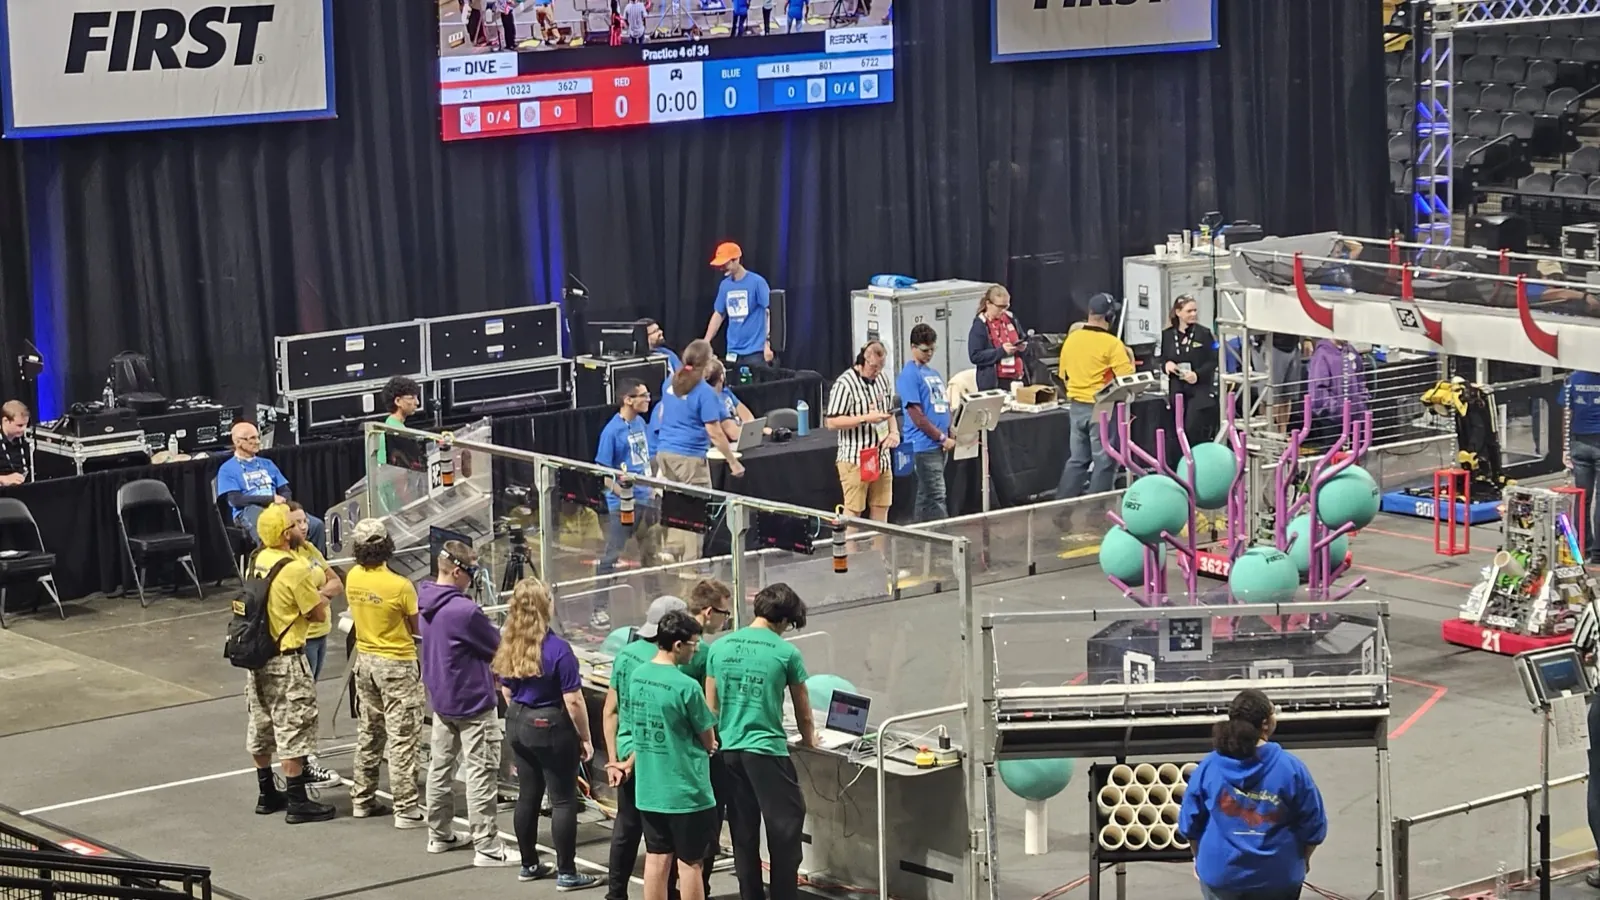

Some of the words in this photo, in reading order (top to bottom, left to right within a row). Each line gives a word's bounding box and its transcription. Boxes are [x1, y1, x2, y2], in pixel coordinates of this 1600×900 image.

[64, 4, 275, 74] FIRST
[829, 33, 868, 45] REEFSCAPE
[642, 47, 678, 60] Practice
[679, 46, 686, 57] 4
[687, 45, 697, 57] of
[697, 45, 709, 56] 34
[465, 59, 497, 75] DIVE
[771, 64, 790, 73] 4118
[819, 62, 832, 70] 801
[861, 58, 879, 67] 6722
[721, 68, 741, 79] BLUE
[614, 77, 630, 87] RED
[463, 90, 472, 99] 21
[506, 85, 531, 96] 10323
[558, 81, 578, 92] 3627
[724, 86, 737, 108] 0
[788, 86, 795, 98] 0
[615, 95, 628, 118] 0
[656, 90, 697, 113] 0:00
[554, 105, 562, 118] 0
[869, 303, 877, 313] 07
[914, 315, 923, 323] 07
[1139, 319, 1149, 331] 08
[1124, 500, 1142, 511] FIRST
[1200, 556, 1230, 576] 3627
[1481, 630, 1501, 652] 21
